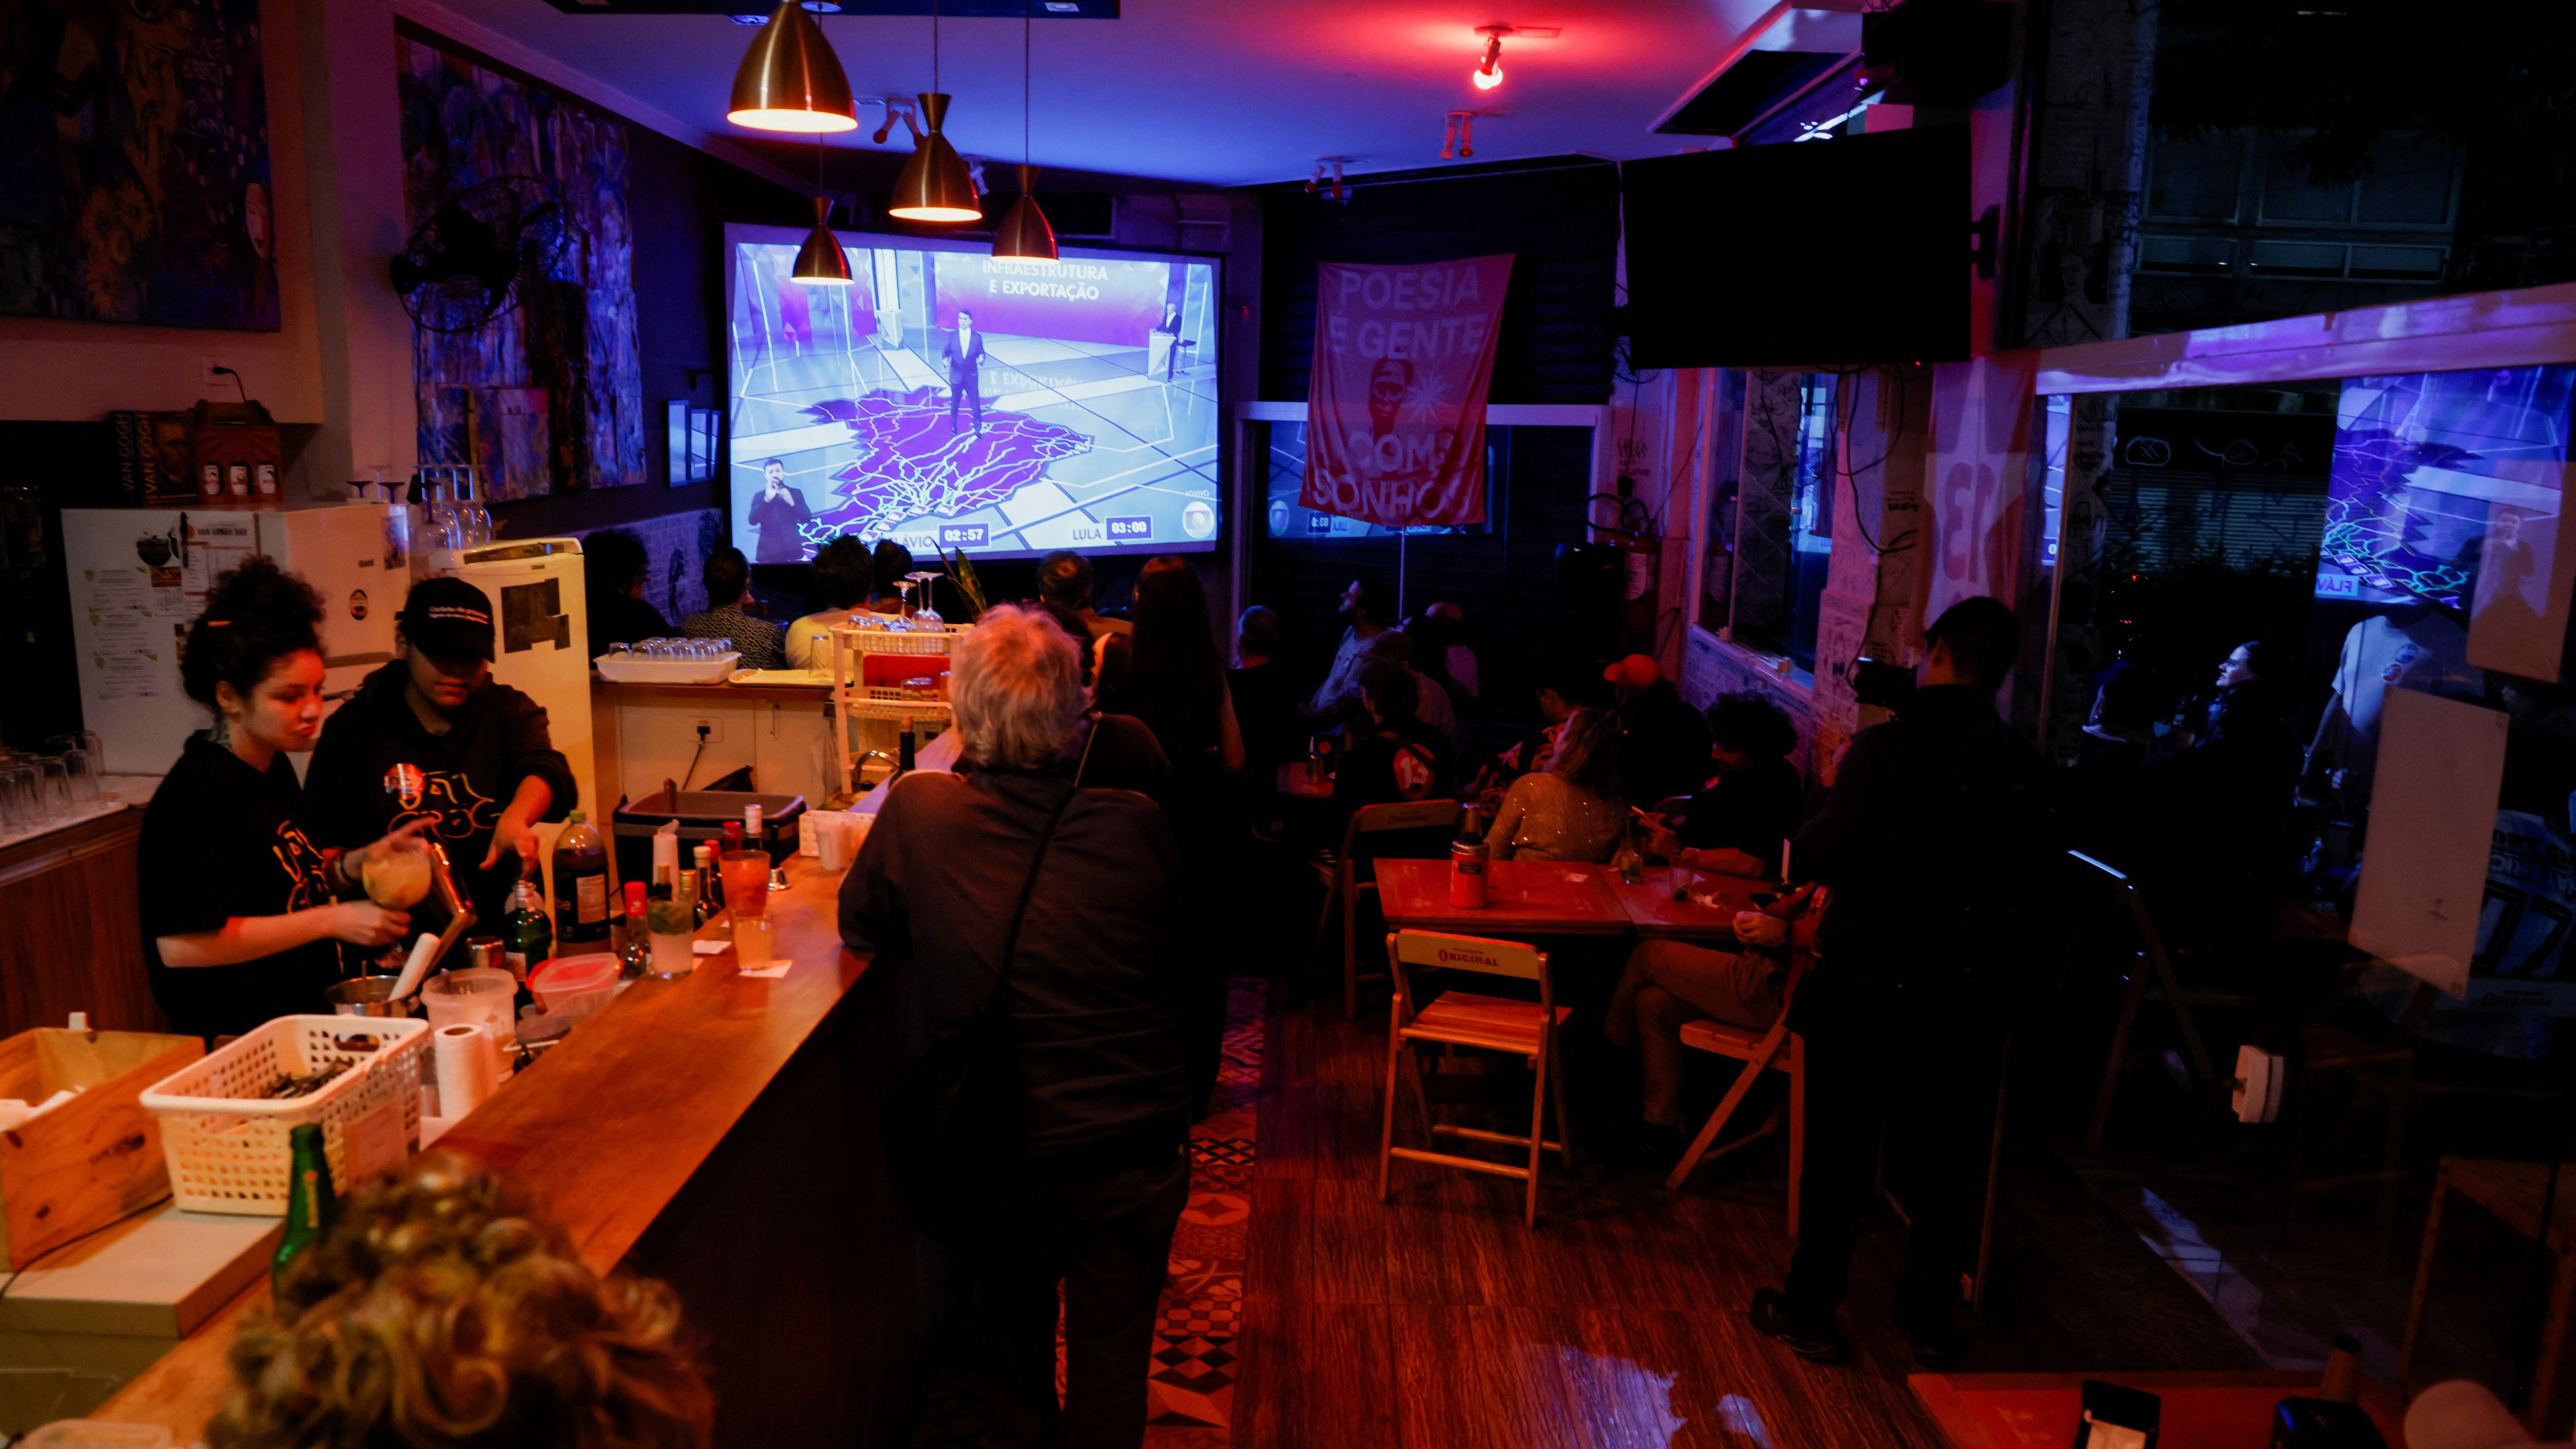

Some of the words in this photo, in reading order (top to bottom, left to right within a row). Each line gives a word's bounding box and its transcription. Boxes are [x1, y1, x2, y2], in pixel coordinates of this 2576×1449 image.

[983, 260, 1108, 281] INFRAESTRUTURA
[989, 279, 998, 293] E
[1002, 281, 1099, 302] EXPORTAÇÃO
[1340, 265, 1479, 310] POESIA
[1359, 313, 1488, 359] GENTE
[1348, 430, 1437, 473] COM
[944, 528, 984, 542] 02:57
[1073, 528, 1102, 540] LULA
[1111, 521, 1147, 534] 03:00
[1400, 756, 1429, 790] 13
[1438, 949, 1499, 967] ORIGINAL
